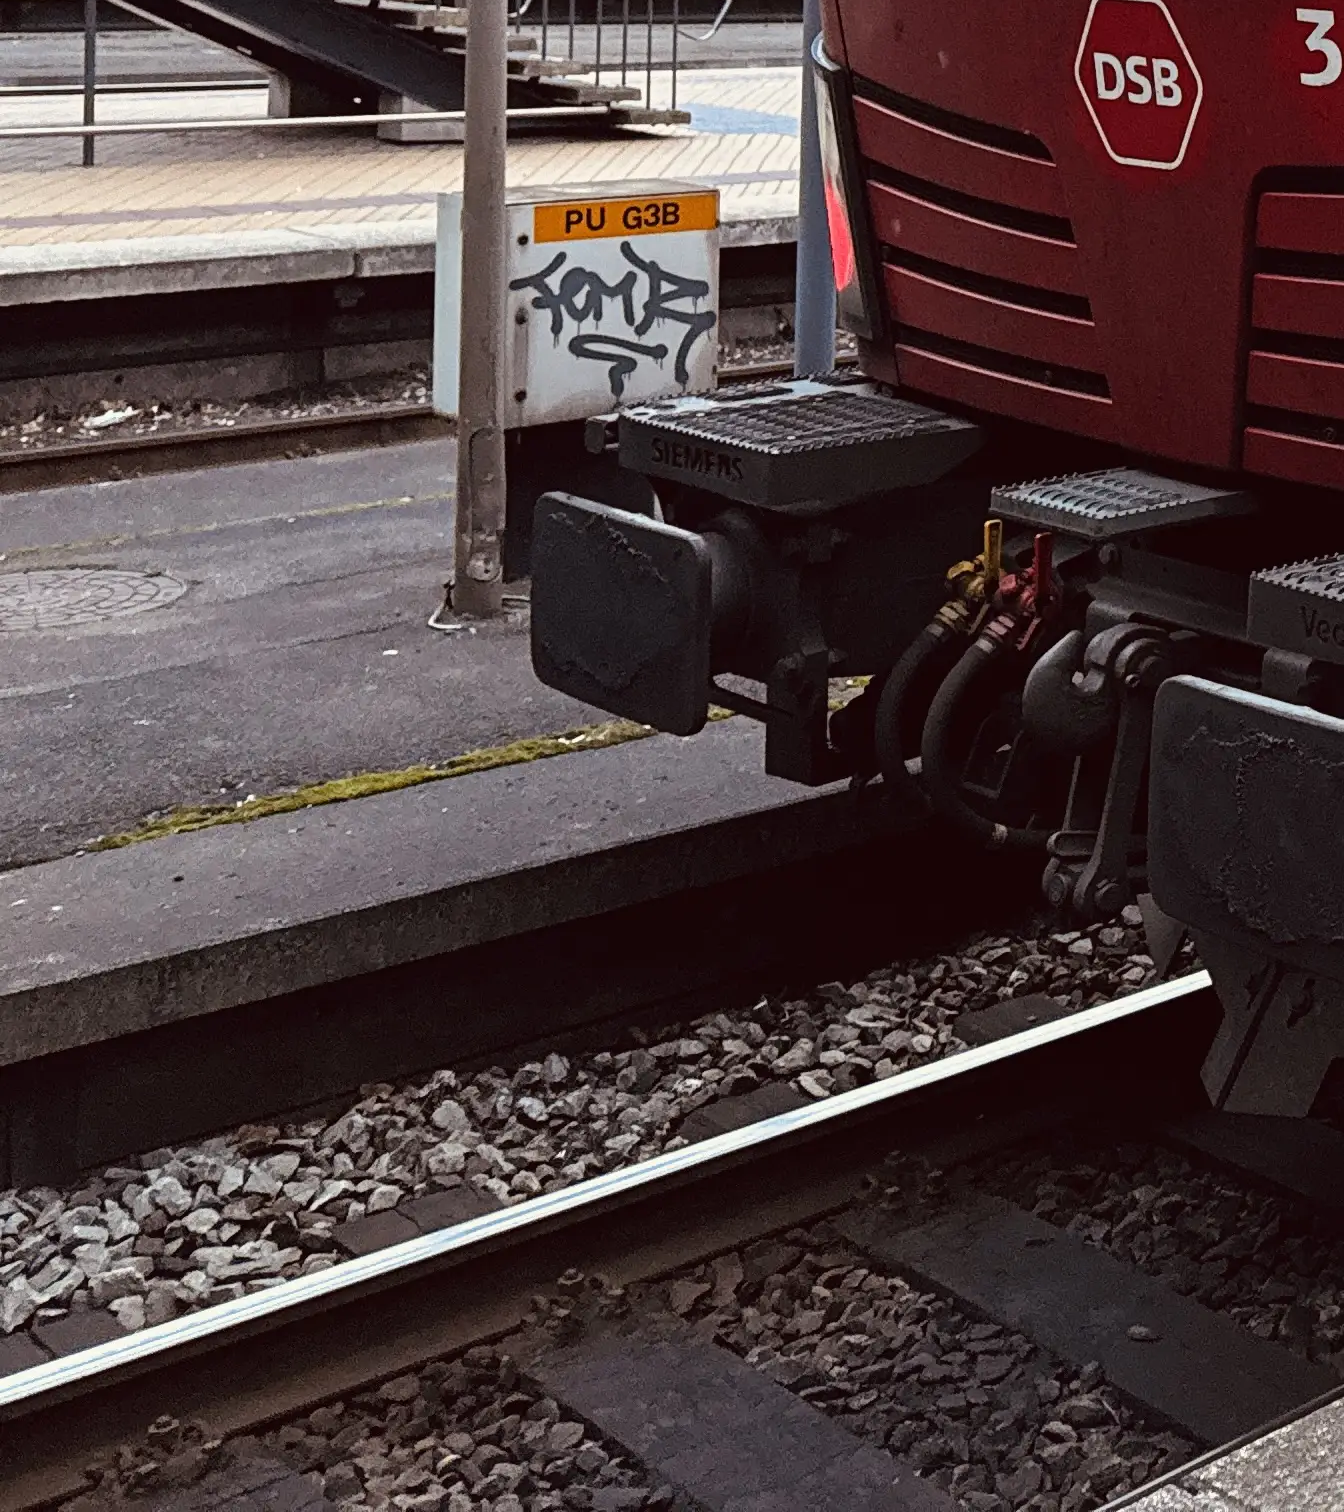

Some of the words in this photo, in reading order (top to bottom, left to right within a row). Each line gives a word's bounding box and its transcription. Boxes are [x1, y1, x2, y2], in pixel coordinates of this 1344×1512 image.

[1093, 51, 1183, 108] DSB
[565, 206, 606, 233] PU
[622, 202, 680, 230] G3B
[650, 436, 744, 483] SIEMENS
